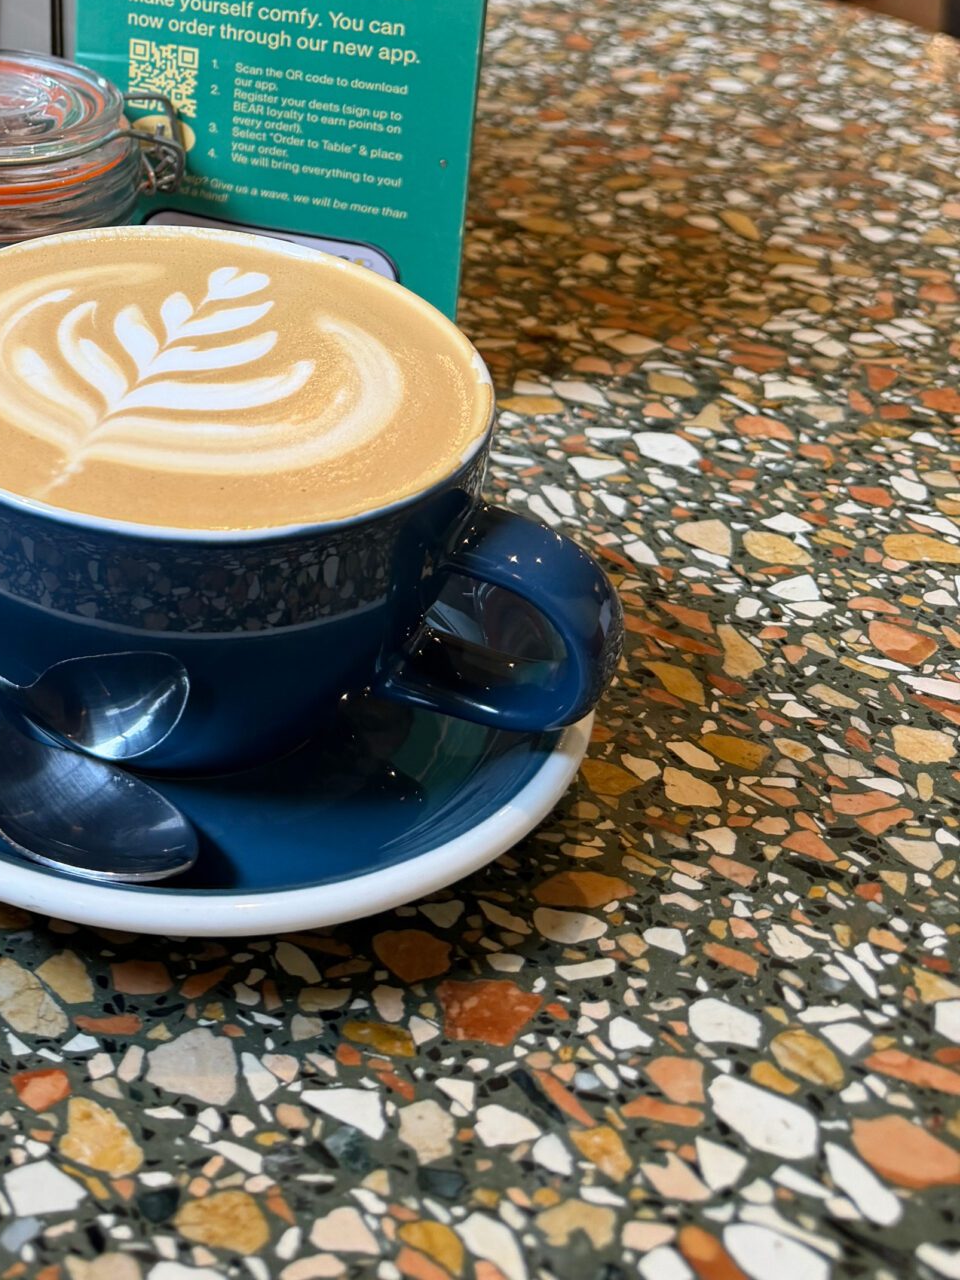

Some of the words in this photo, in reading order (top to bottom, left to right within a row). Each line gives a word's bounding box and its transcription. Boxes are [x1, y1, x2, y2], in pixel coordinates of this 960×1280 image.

[128, 13, 164, 28] now
[168, 18, 214, 37] order
[220, 24, 291, 50] through
[297, 35, 327, 51] our
[333, 41, 373, 57] new
[378, 47, 421, 66] app.
[258, 7, 322, 29] comfy.
[328, 11, 363, 32] You
[368, 19, 405, 36] can
[211, 59, 219, 69] 1.
[235, 62, 262, 76] Scan
[266, 68, 283, 79] the
[285, 69, 303, 81] QR
[305, 74, 334, 85] code
[337, 76, 348, 87] to
[351, 77, 408, 95] download
[234, 78, 252, 87] our
[255, 80, 278, 92] app.
[210, 85, 220, 95] 2.
[234, 89, 278, 104] Register
[281, 96, 306, 108] your
[308, 100, 340, 113] deets
[342, 104, 370, 119] (sign
[373, 108, 387, 121] up
[390, 111, 402, 120] to
[233, 101, 264, 114] BEAR
[266, 104, 303, 121] loyalty
[307, 112, 318, 122] to
[321, 115, 346, 126] earn
[348, 116, 384, 133] points
[386, 124, 401, 134] on
[233, 116, 261, 128] every
[208, 122, 218, 133] 3.
[232, 128, 266, 141] Select
[307, 138, 319, 149] to
[359, 145, 368, 156] &
[370, 148, 403, 161] place
[232, 142, 255, 154] your
[258, 145, 288, 158] order.
[208, 148, 217, 158] 4.
[231, 152, 247, 165] We
[250, 155, 269, 168] will
[271, 159, 299, 174] bring
[302, 164, 360, 183] everything
[363, 173, 374, 183] to
[377, 174, 402, 188] you!
[210, 178, 233, 192] Give
[235, 185, 248, 194] us
[250, 186, 258, 195] a
[260, 189, 289, 202] wave,
[293, 194, 310, 204] we
[312, 196, 331, 208] will
[333, 199, 348, 210] be
[350, 202, 379, 215] more
[382, 207, 407, 219] than
